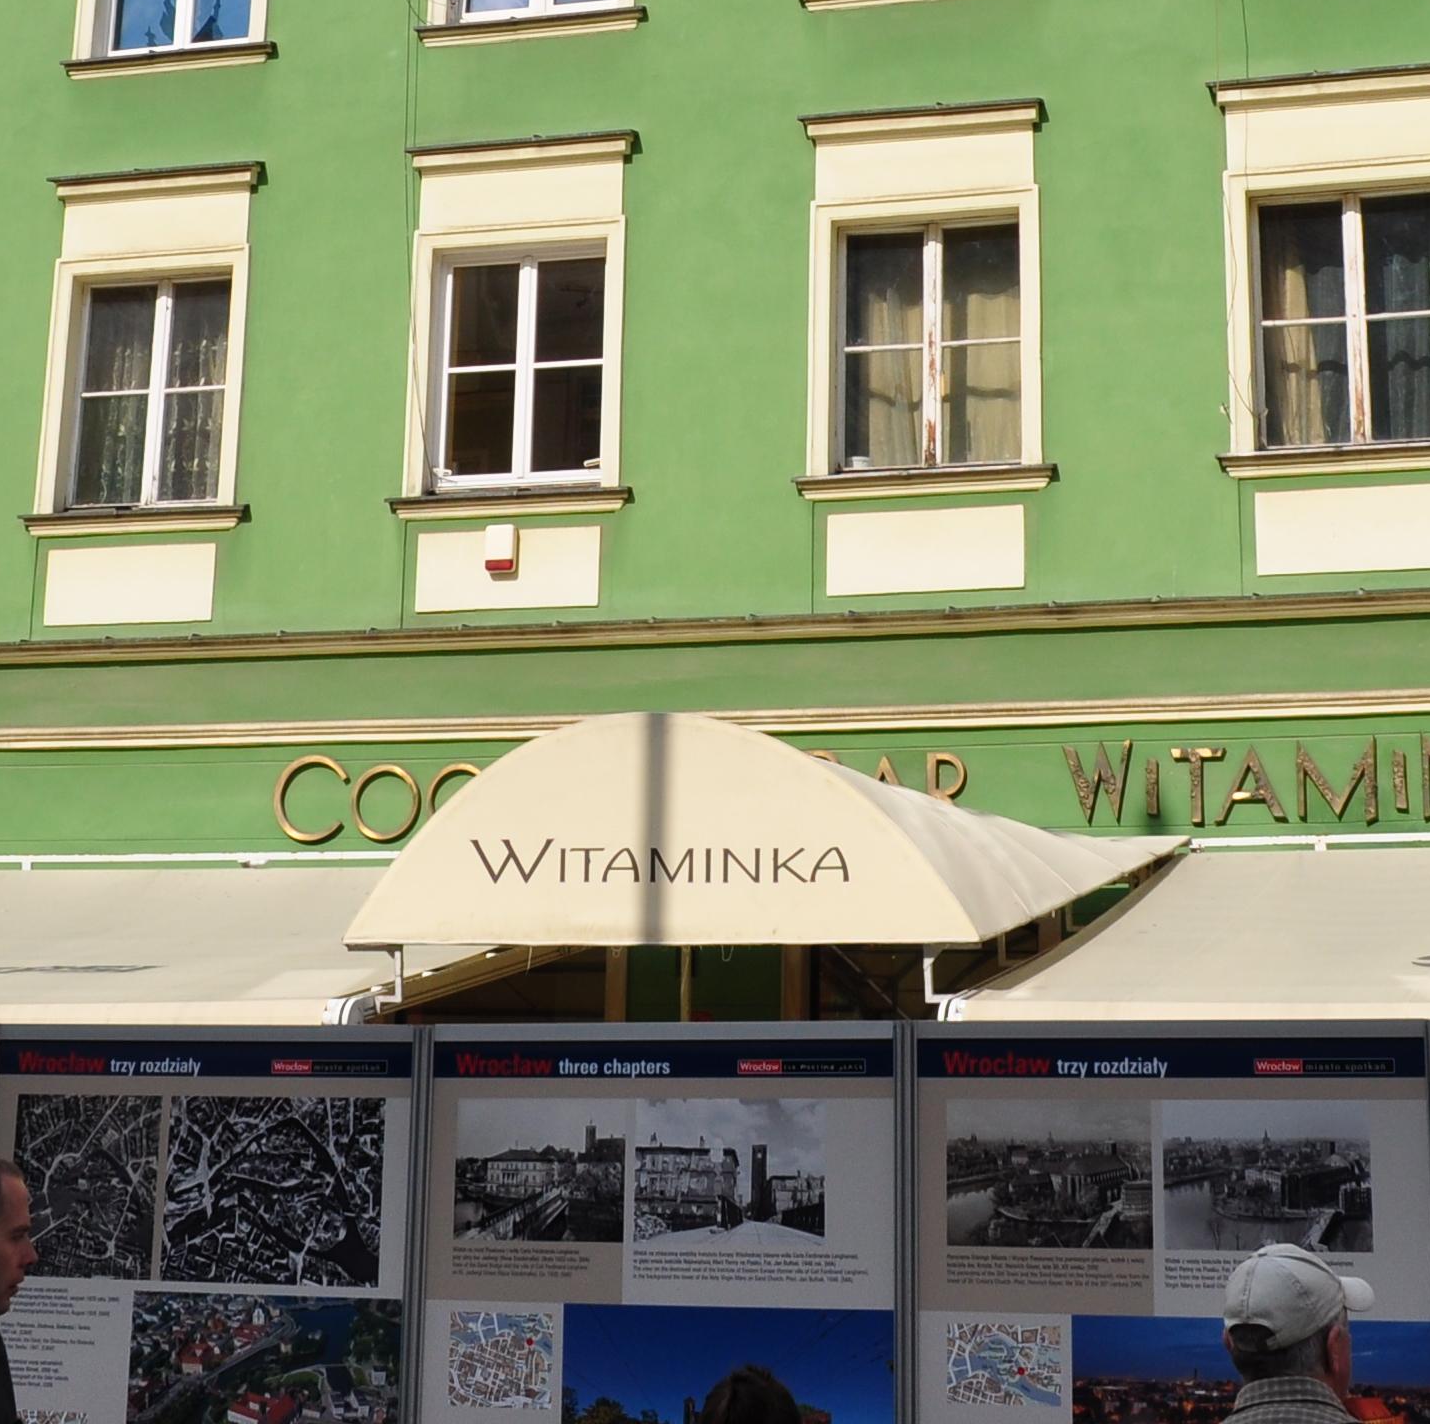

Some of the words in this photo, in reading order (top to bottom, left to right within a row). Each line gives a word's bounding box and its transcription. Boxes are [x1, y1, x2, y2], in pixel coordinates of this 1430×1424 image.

[17, 1050, 105, 1072] Wrocław
[110, 1058, 136, 1076] trzy
[139, 1057, 201, 1077] rozdziały
[456, 1051, 552, 1075] Wrocław
[558, 1057, 599, 1075] three
[603, 1057, 670, 1079] chapters
[739, 1060, 779, 1071] Wrocław
[943, 1051, 1050, 1074] Wrocław
[1057, 1058, 1087, 1078] trzy
[1093, 1057, 1168, 1078] rozdziały
[1256, 1060, 1300, 1071] Wrocław
